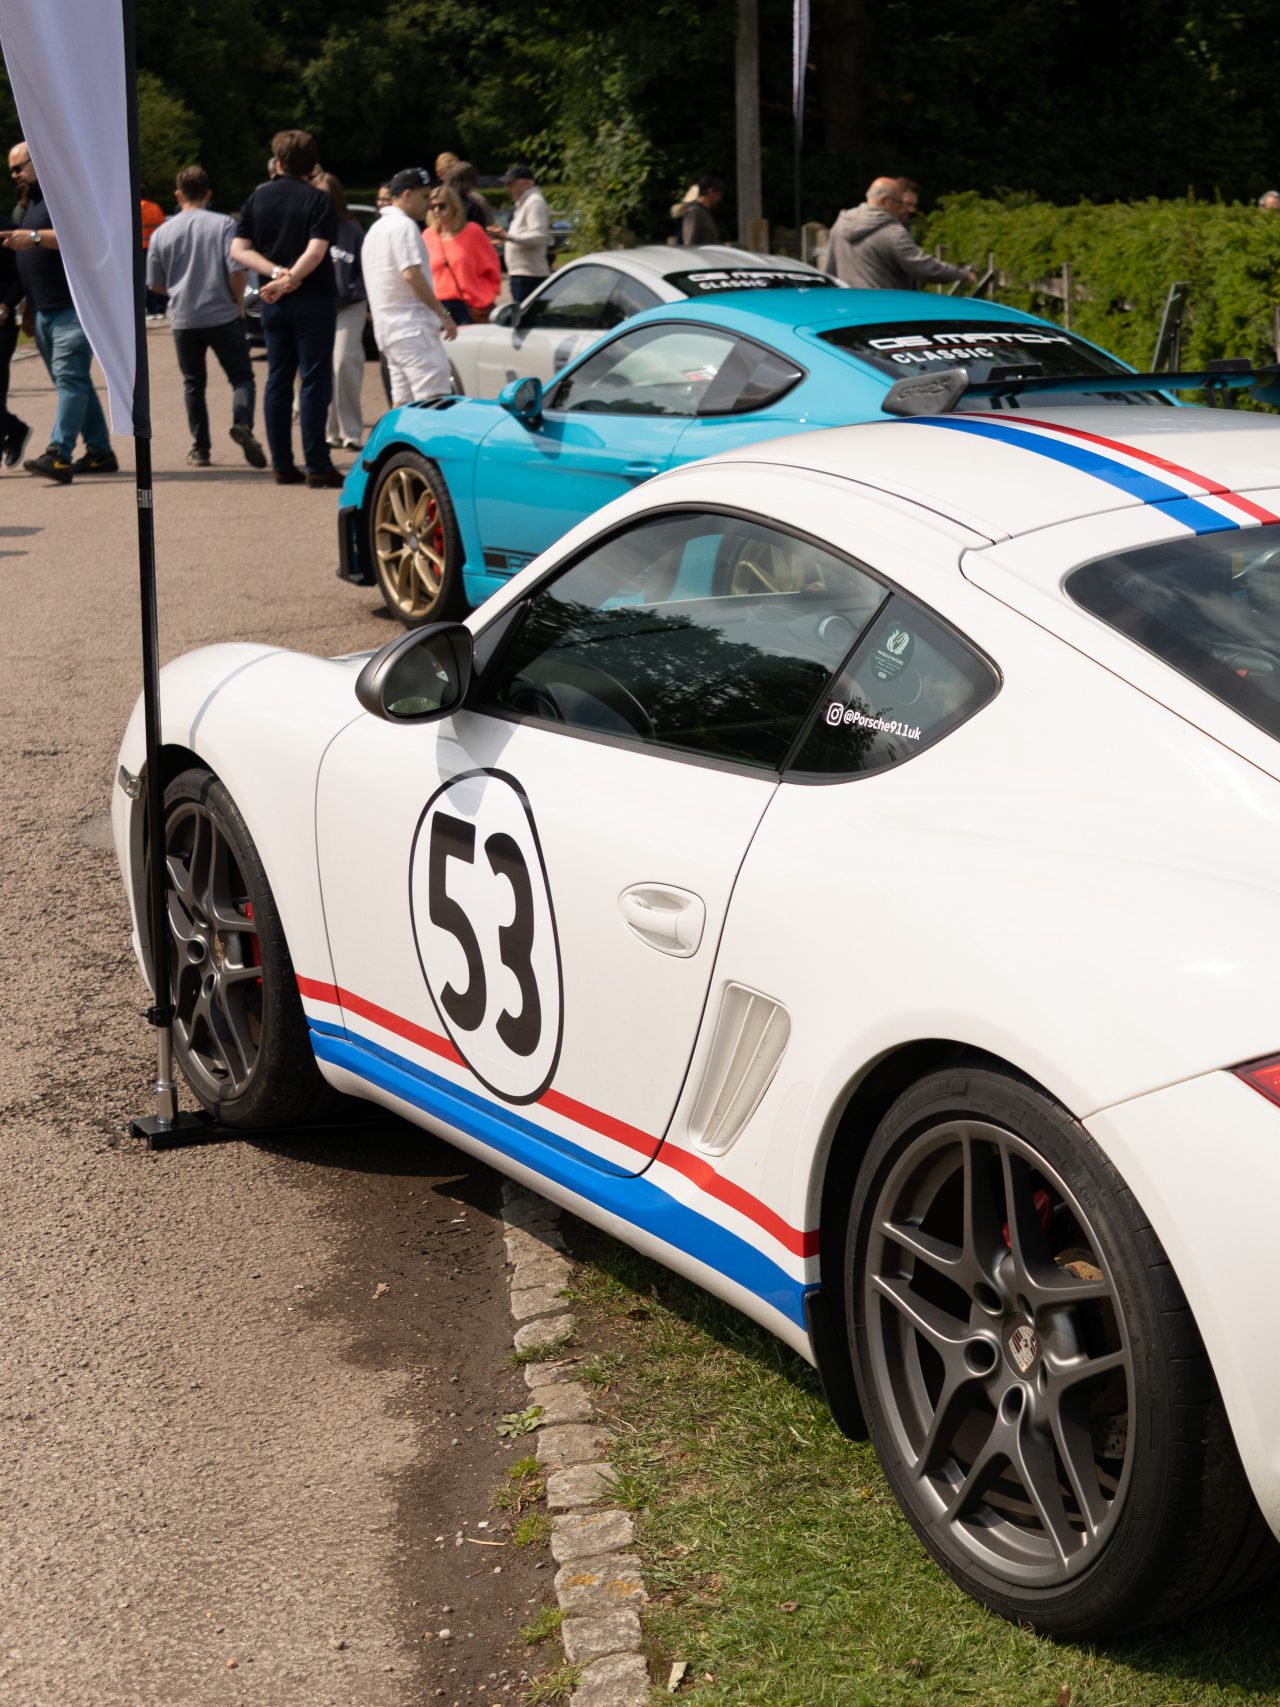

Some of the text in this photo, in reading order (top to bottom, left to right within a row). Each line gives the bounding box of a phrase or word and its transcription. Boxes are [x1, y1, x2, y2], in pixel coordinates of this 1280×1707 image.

[698, 279, 768, 290] CLASSIC
[891, 346, 994, 365] CLASSIC
[843, 709, 922, 741] @Porsche911uk
[428, 810, 542, 1057] 53
